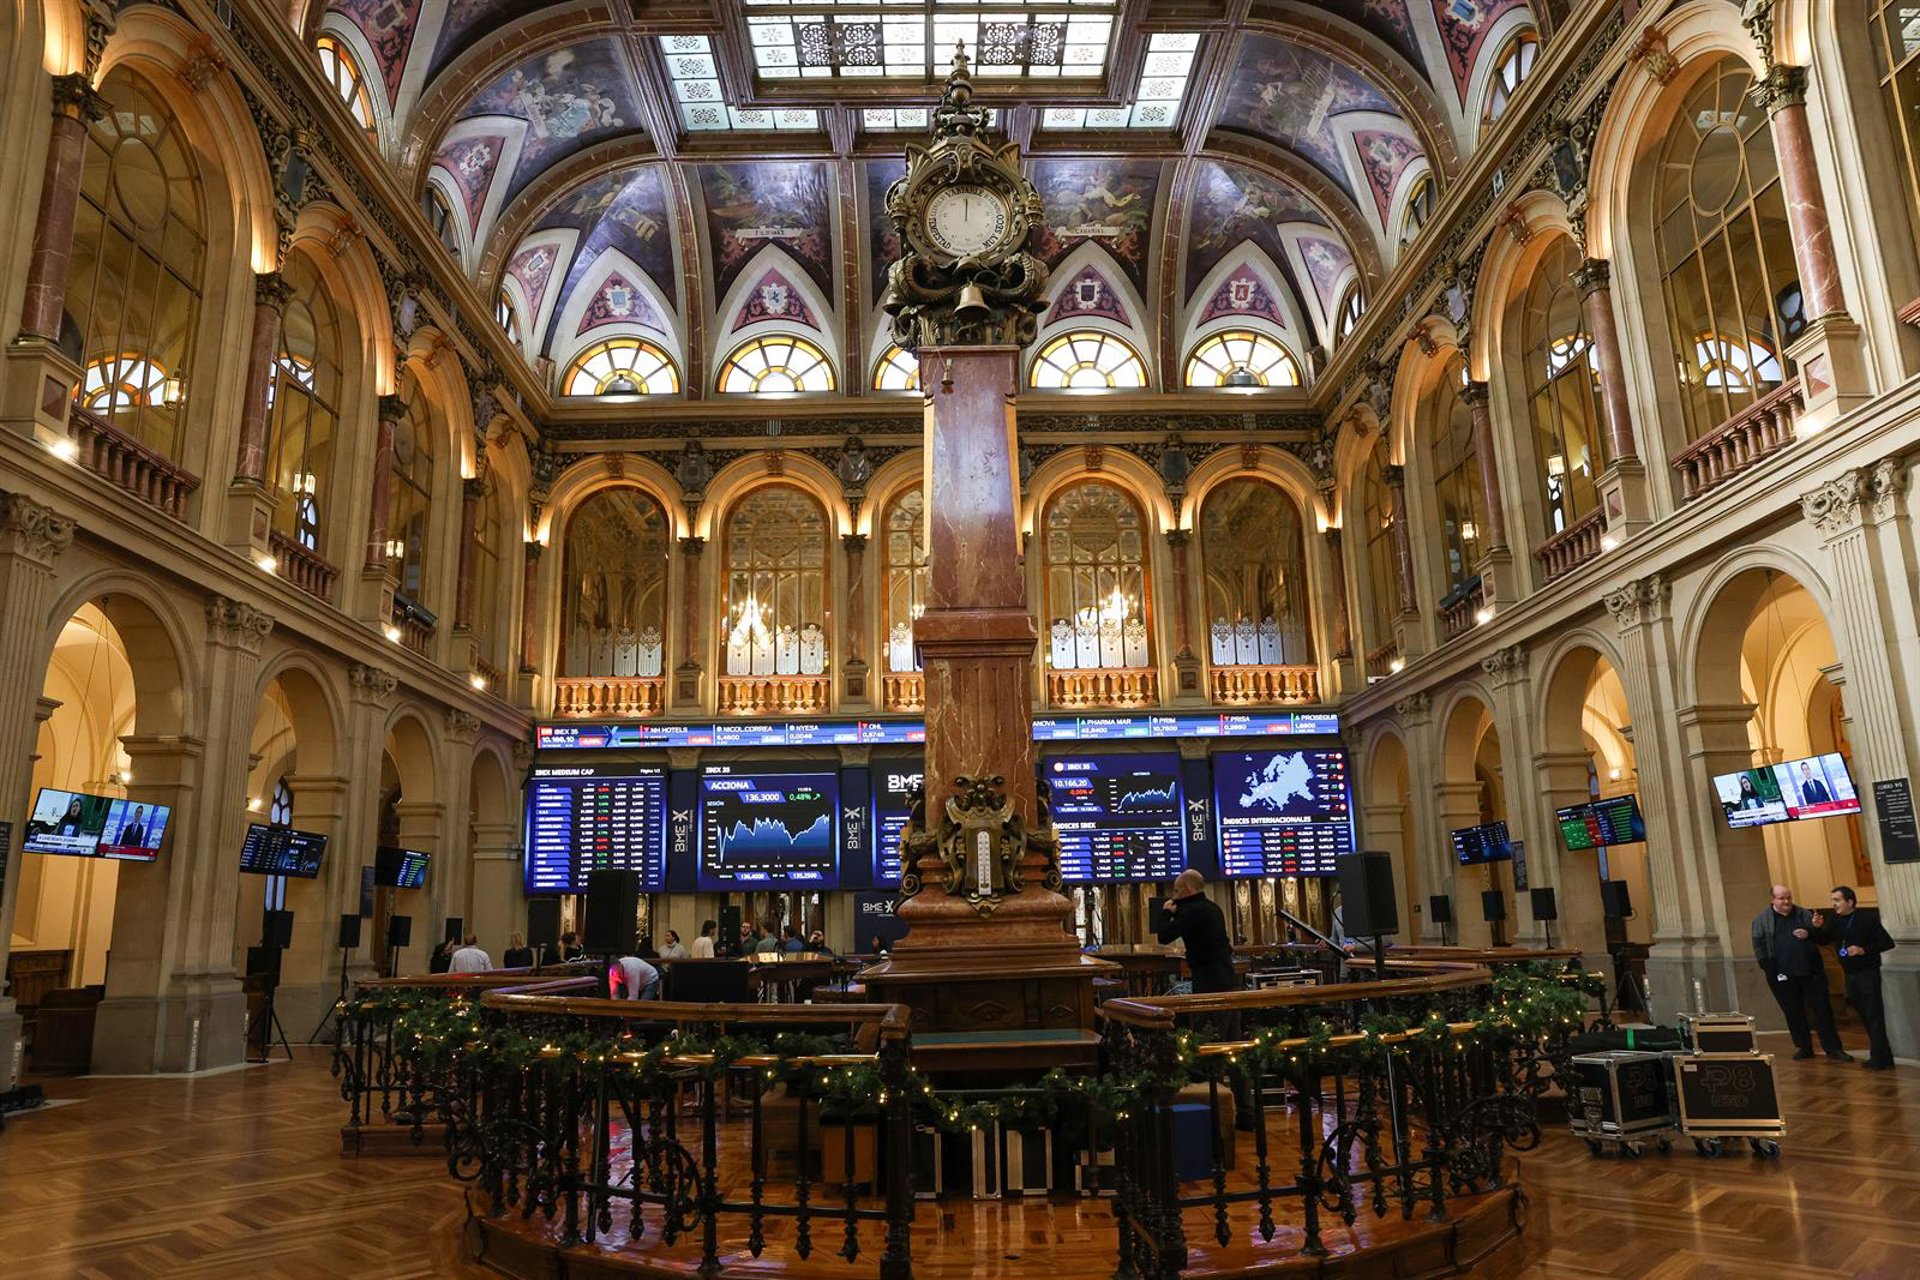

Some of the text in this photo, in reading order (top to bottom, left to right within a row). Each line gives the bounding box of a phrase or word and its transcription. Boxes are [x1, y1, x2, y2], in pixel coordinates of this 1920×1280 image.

[983, 214, 1004, 249] MUY SECO
[711, 781, 749, 790] ACCIONA
[1052, 822, 1079, 830] ÍNDICES
[1191, 814, 1203, 841] BME
[1223, 816, 1312, 825] ÍNDICES INTERNACIONALES
[674, 825, 685, 852] BME
[847, 822, 858, 849] BME
[862, 902, 882, 912] BME
